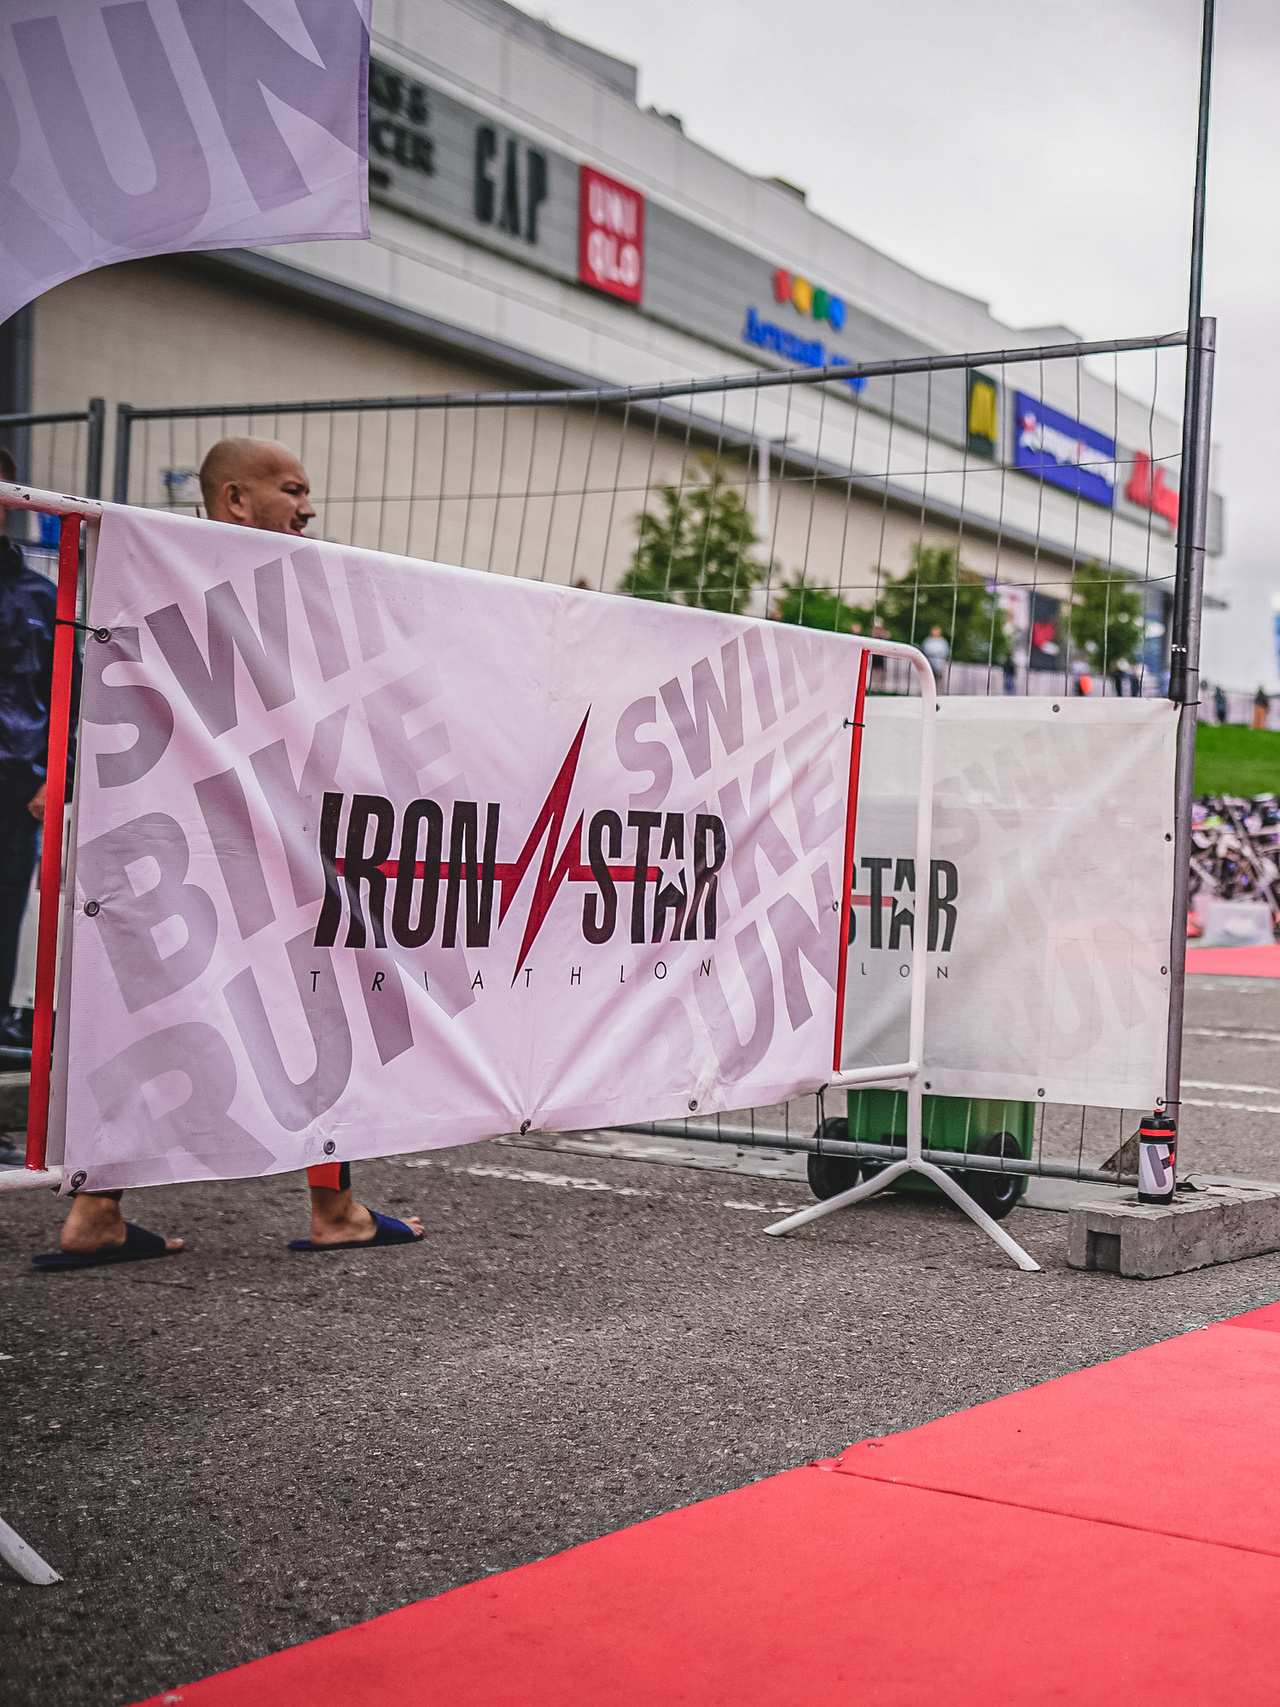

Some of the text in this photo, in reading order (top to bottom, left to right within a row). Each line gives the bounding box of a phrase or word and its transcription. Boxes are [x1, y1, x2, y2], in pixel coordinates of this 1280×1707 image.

[474, 125, 548, 244] GAP
[588, 179, 638, 239] UNI
[587, 229, 641, 287] QLO
[312, 791, 727, 949] IRON STAR
[311, 958, 712, 992] TRIATHLON
